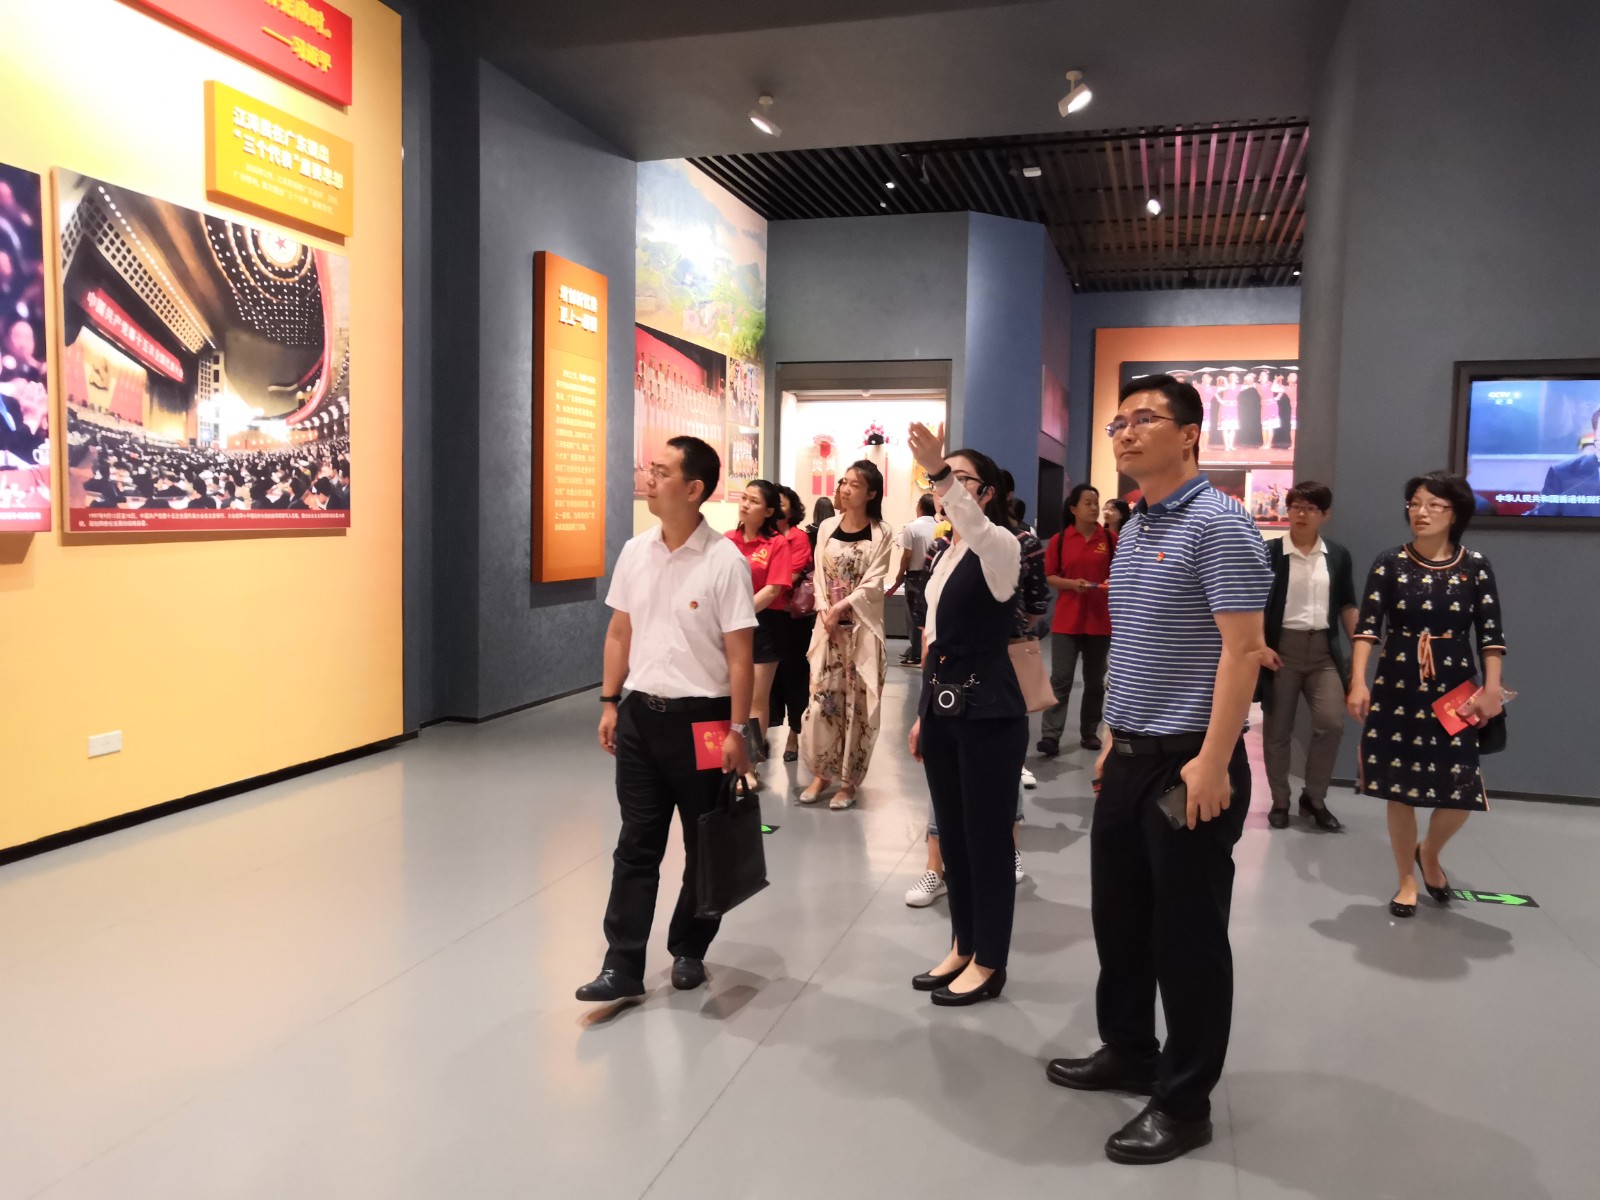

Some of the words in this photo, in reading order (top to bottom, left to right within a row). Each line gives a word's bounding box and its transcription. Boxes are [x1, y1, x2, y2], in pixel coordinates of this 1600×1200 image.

[232, 106, 330, 164] 江泽民在广东提出
